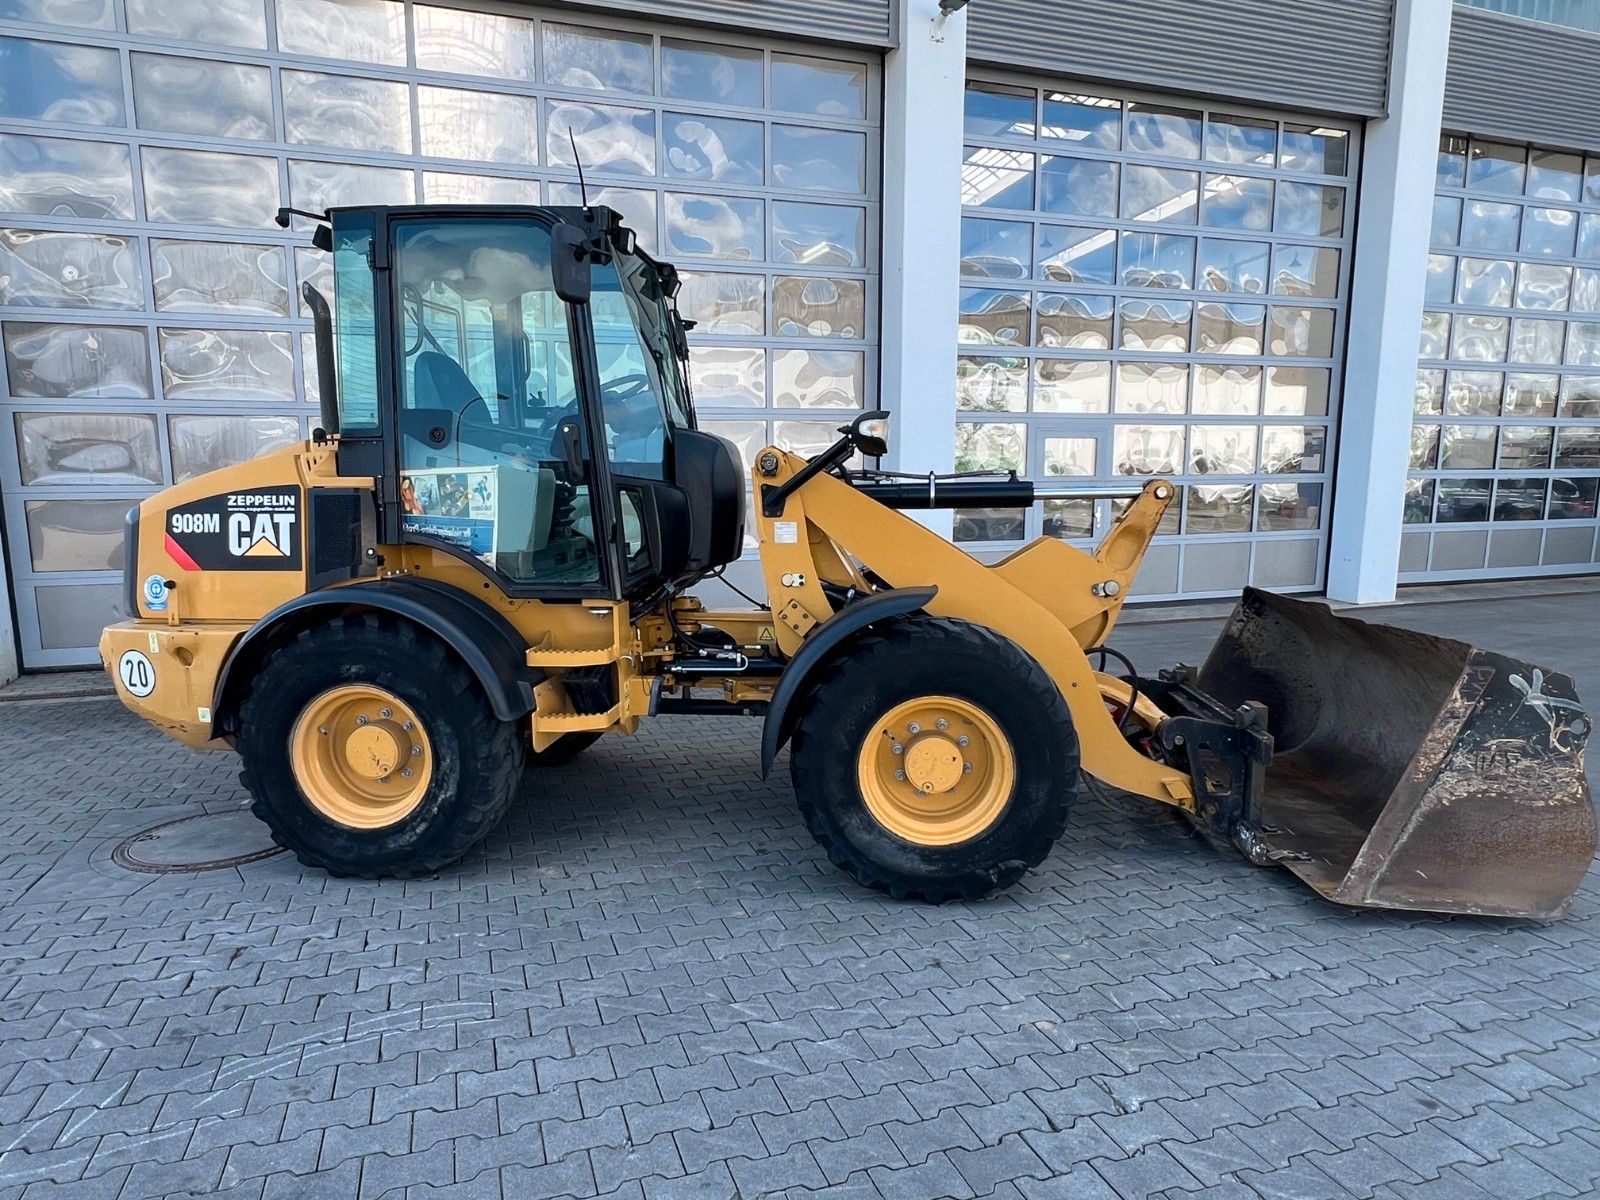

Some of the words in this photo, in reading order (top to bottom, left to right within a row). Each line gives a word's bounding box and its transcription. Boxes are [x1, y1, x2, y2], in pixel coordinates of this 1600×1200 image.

[227, 495, 295, 506] ZEPPELIN
[172, 513, 220, 533] 908M
[228, 513, 295, 556] CAT
[126, 660, 148, 687] 20
